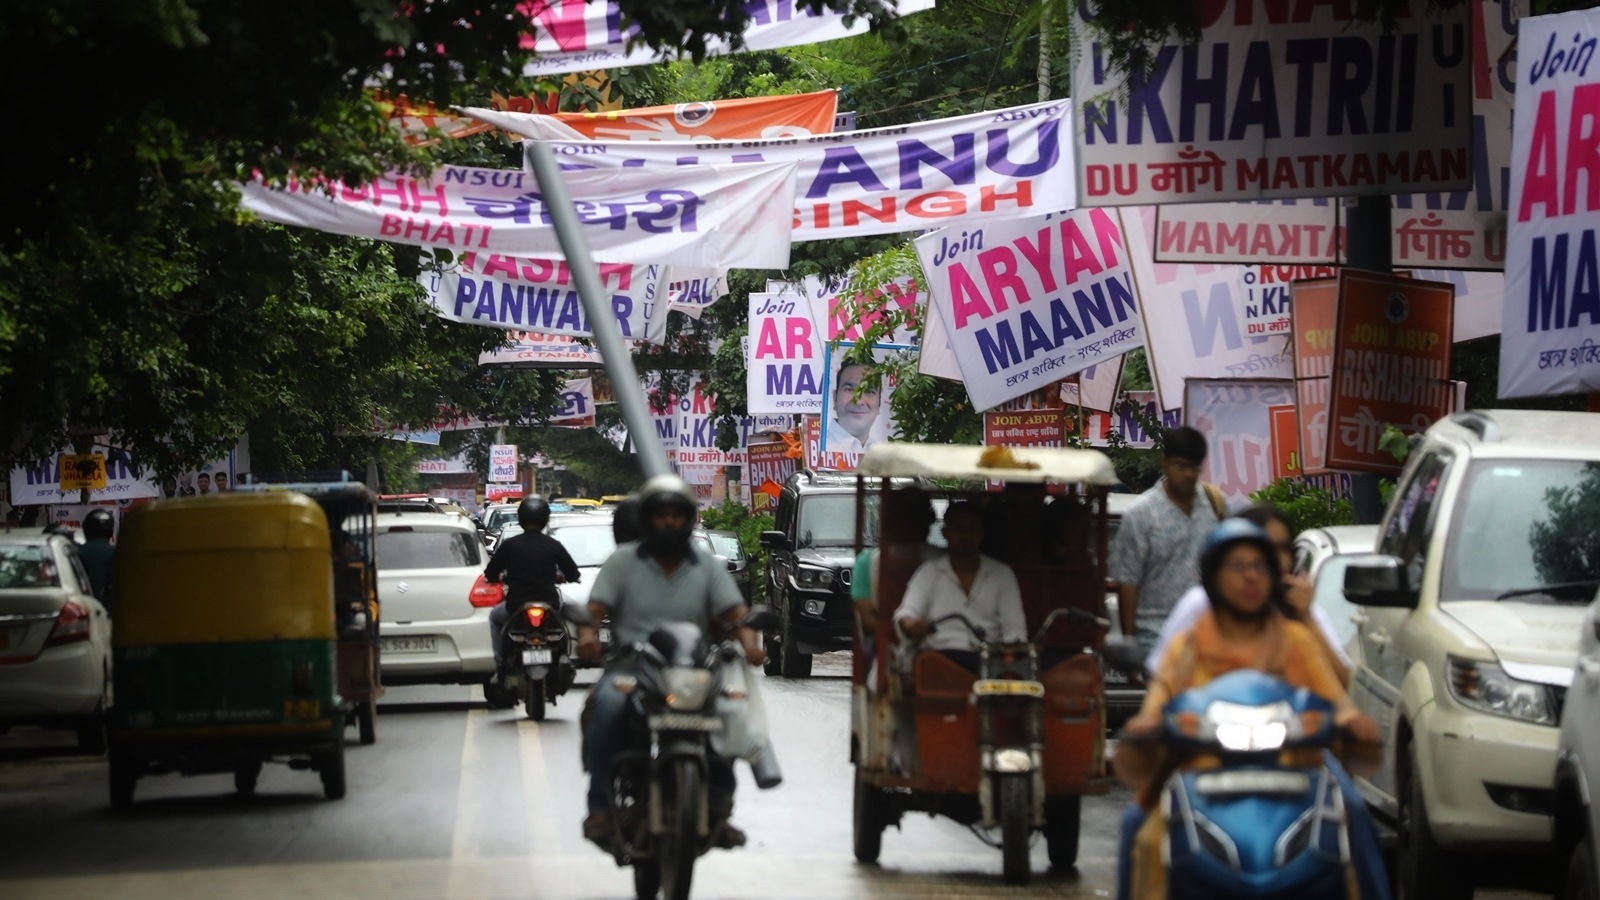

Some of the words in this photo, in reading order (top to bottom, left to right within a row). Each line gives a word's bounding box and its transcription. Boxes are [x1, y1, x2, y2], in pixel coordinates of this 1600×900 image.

[1530, 32, 1598, 85] Join
[992, 105, 1061, 123] ABVP
[445, 168, 526, 189] NSUI
[1086, 162, 1138, 197] DU
[1236, 147, 1467, 192] MATKAMAN
[380, 213, 493, 248] BHATI
[933, 228, 984, 267] Join
[948, 207, 1123, 330] ARYAN
[643, 263, 660, 339] NSUI
[756, 298, 796, 316] Join
[975, 271, 1138, 375] MAANN
[1248, 323, 1265, 334] DU
[1349, 324, 1389, 346] JOIN
[1394, 328, 1441, 353] ABVP
[766, 364, 824, 396] MA
[1341, 348, 1442, 409] RISHABHH
[992, 415, 1022, 426] JOIN
[1025, 414, 1059, 425] ABVP
[680, 452, 695, 463] DU
